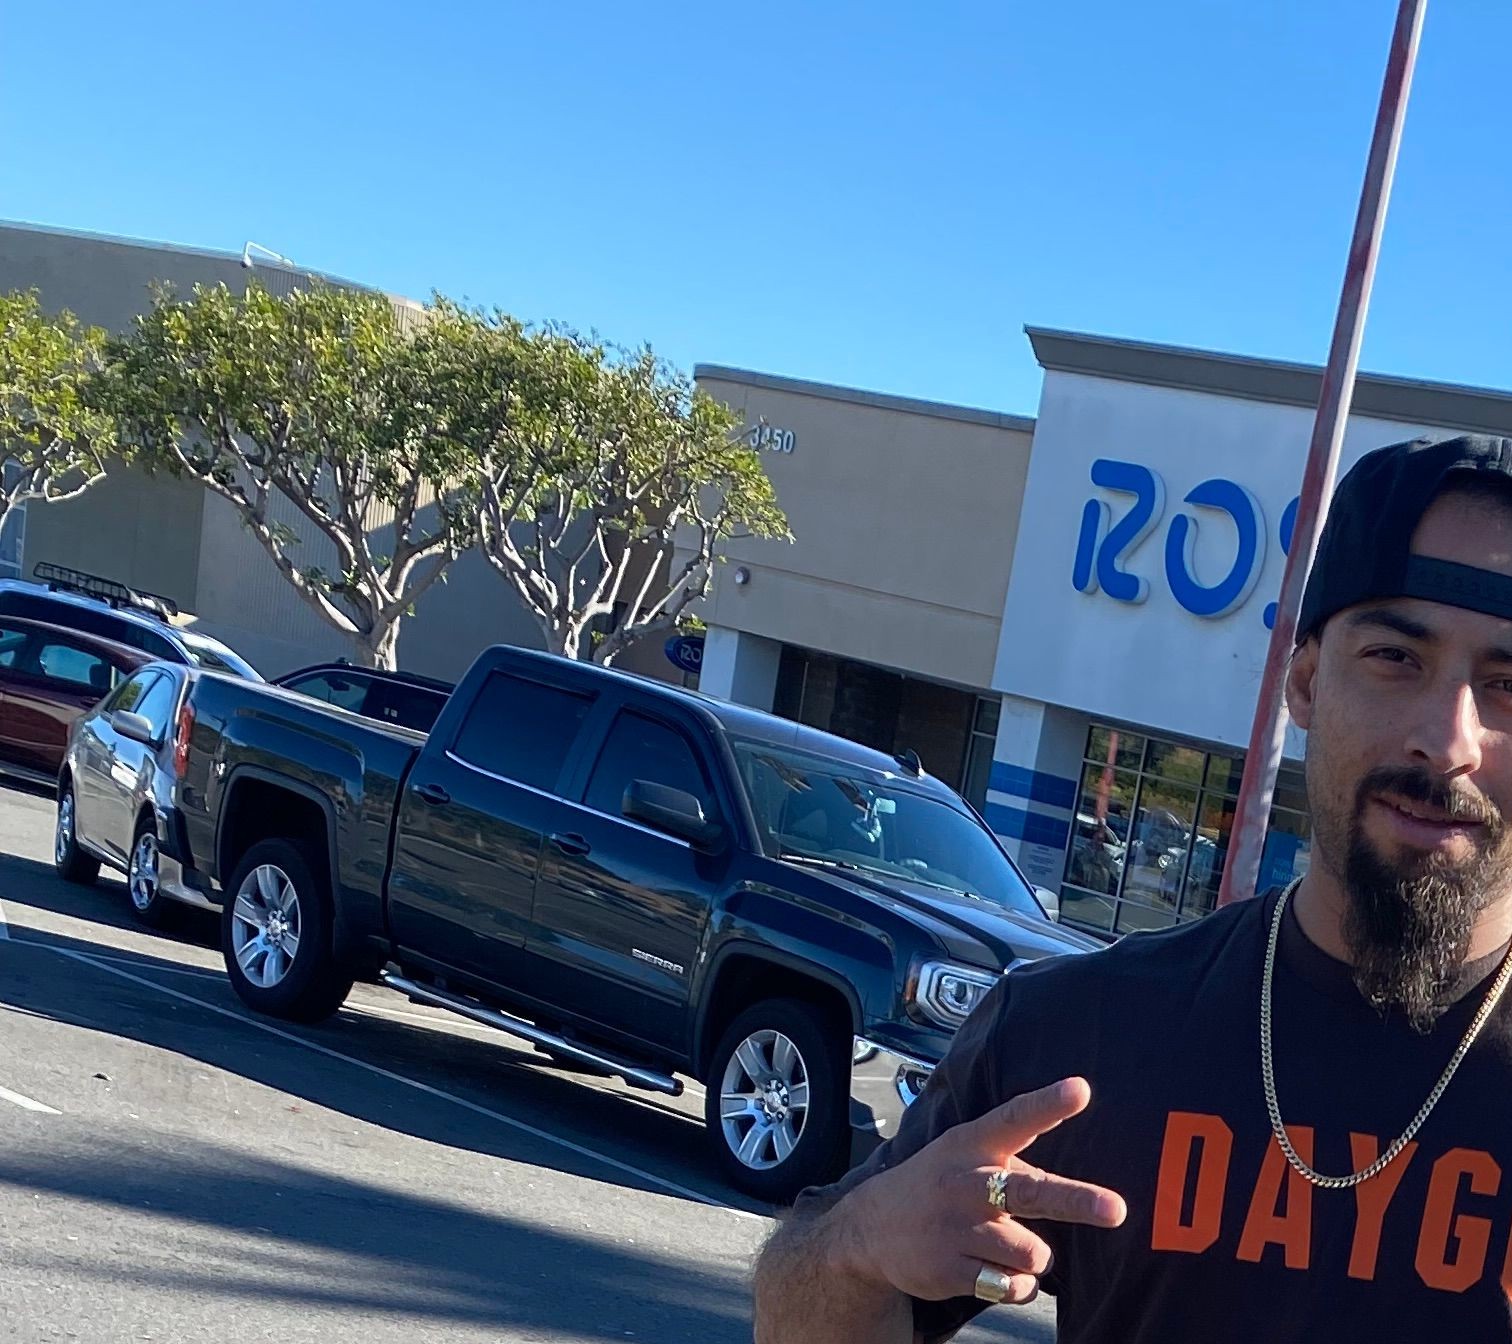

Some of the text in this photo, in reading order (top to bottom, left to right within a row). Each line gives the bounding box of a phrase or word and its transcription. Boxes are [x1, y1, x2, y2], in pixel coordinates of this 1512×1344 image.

[750, 424, 794, 453] 3450
[1072, 458, 1301, 630] RO
[681, 643, 702, 663] RO
[632, 948, 684, 974] SIERRA
